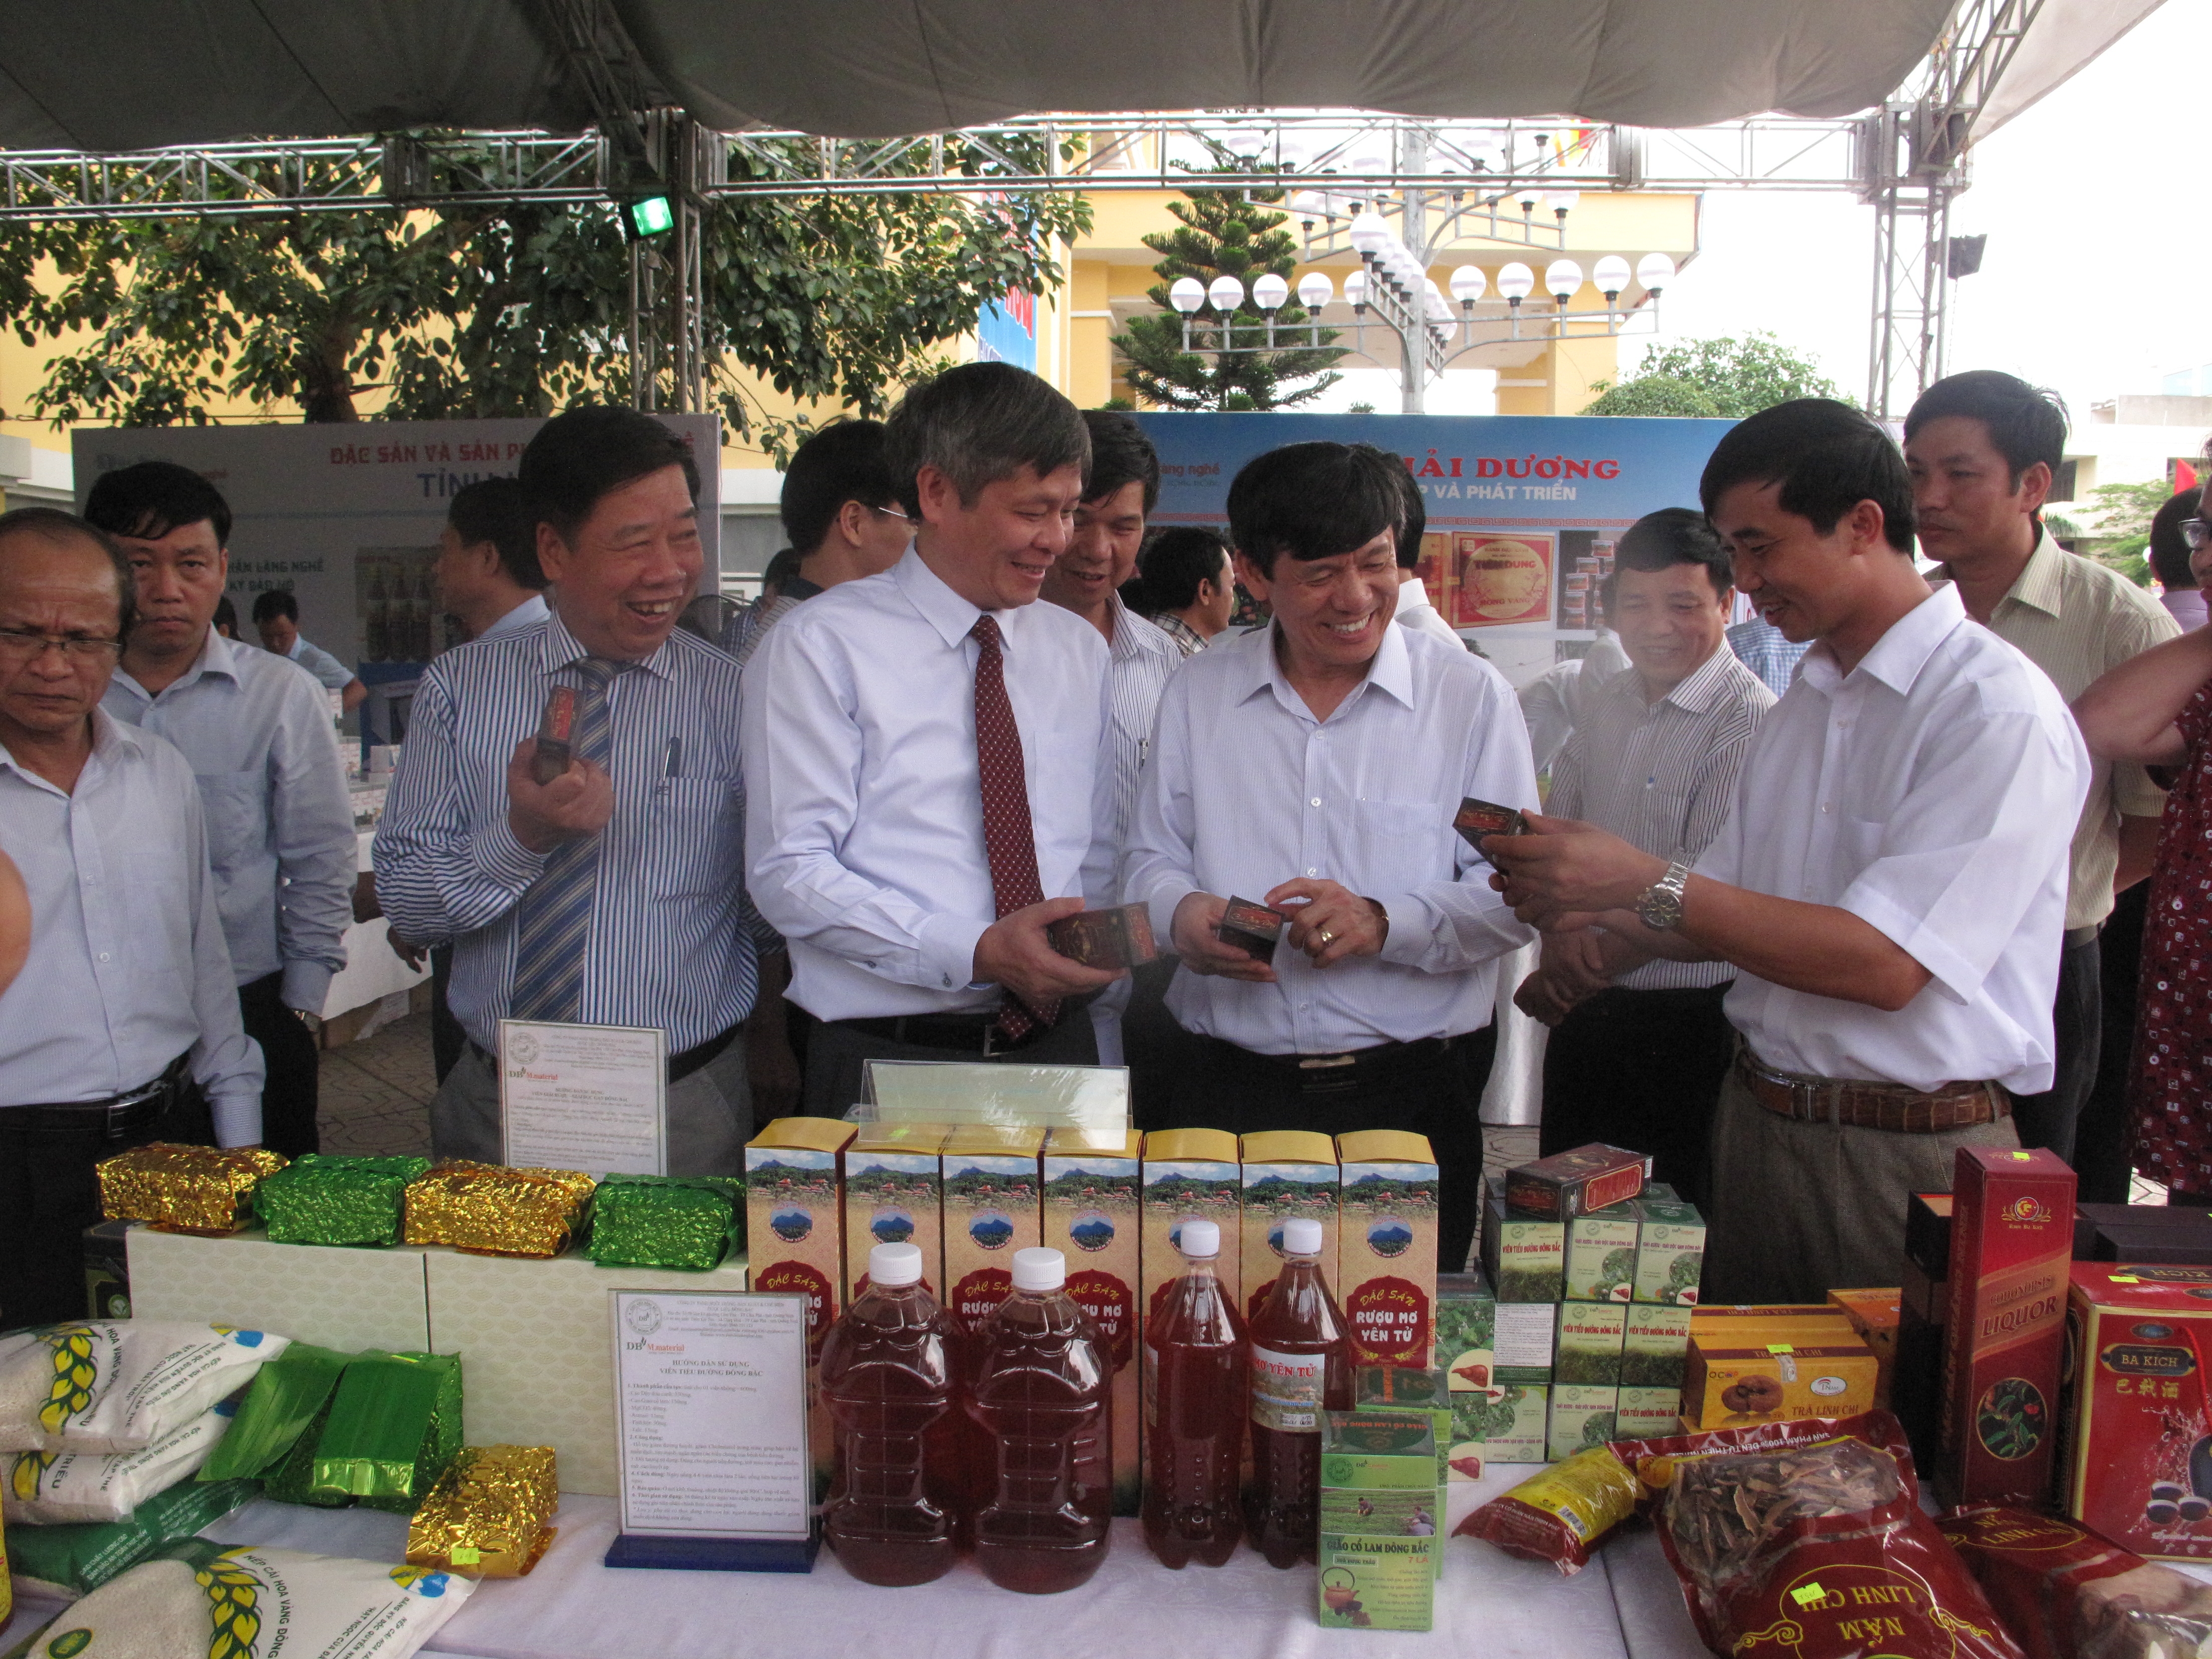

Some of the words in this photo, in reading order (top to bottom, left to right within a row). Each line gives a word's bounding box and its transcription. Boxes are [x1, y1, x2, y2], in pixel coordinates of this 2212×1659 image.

[378, 441, 417, 462] SẢN
[425, 440, 451, 462] VÀ
[459, 439, 499, 461] SẢN
[1476, 454, 1621, 479] DƯƠNG
[1434, 482, 1461, 499] VÀ
[1467, 482, 1517, 500] PHÁT
[1522, 479, 1576, 500] TRIỂN
[766, 1272, 790, 1289] ĐẶC
[2150, 1269, 2210, 1277] KICH
[965, 1281, 989, 1297] ĐẶC
[1065, 1282, 1089, 1297] ĐẶC
[1359, 1288, 1384, 1305] ĐẶC
[1103, 1303, 1122, 1317] MƠ
[1355, 1309, 1394, 1325] RƯỢU
[1399, 1309, 1419, 1324] MƠ
[1981, 1295, 2058, 1338] LIQUOR
[106, 1327, 121, 1345] HOA
[1360, 1325, 1388, 1342] YÊN
[1394, 1325, 1413, 1342] TỬ
[2122, 1354, 2139, 1365] BA
[2144, 1356, 2178, 1367] KICH
[1269, 1361, 1294, 1376] YÊN
[1297, 1363, 1318, 1377] TỬ
[1816, 1405, 1841, 1416] LINH
[1842, 1405, 1859, 1415] CHI
[1364, 1541, 1382, 1552] LAM
[1385, 1542, 1410, 1553] ĐÔNG
[1411, 1540, 1429, 1553] BẮC
[244, 1554, 267, 1567] NẾP
[1416, 1555, 1429, 1563] LÁ
[263, 1566, 281, 1579] CÁI
[273, 1579, 290, 1598] HOA
[1848, 1585, 1916, 1604] LINH
[279, 1598, 292, 1625] VÀNG
[342, 1619, 362, 1637] NGỌC
[396, 1616, 408, 1629] NẾP
[1835, 1616, 1906, 1648] NẤM
[327, 1636, 345, 1652] CỦA
[353, 1630, 375, 1651] QUYỀN
[371, 1637, 385, 1651] HOA
